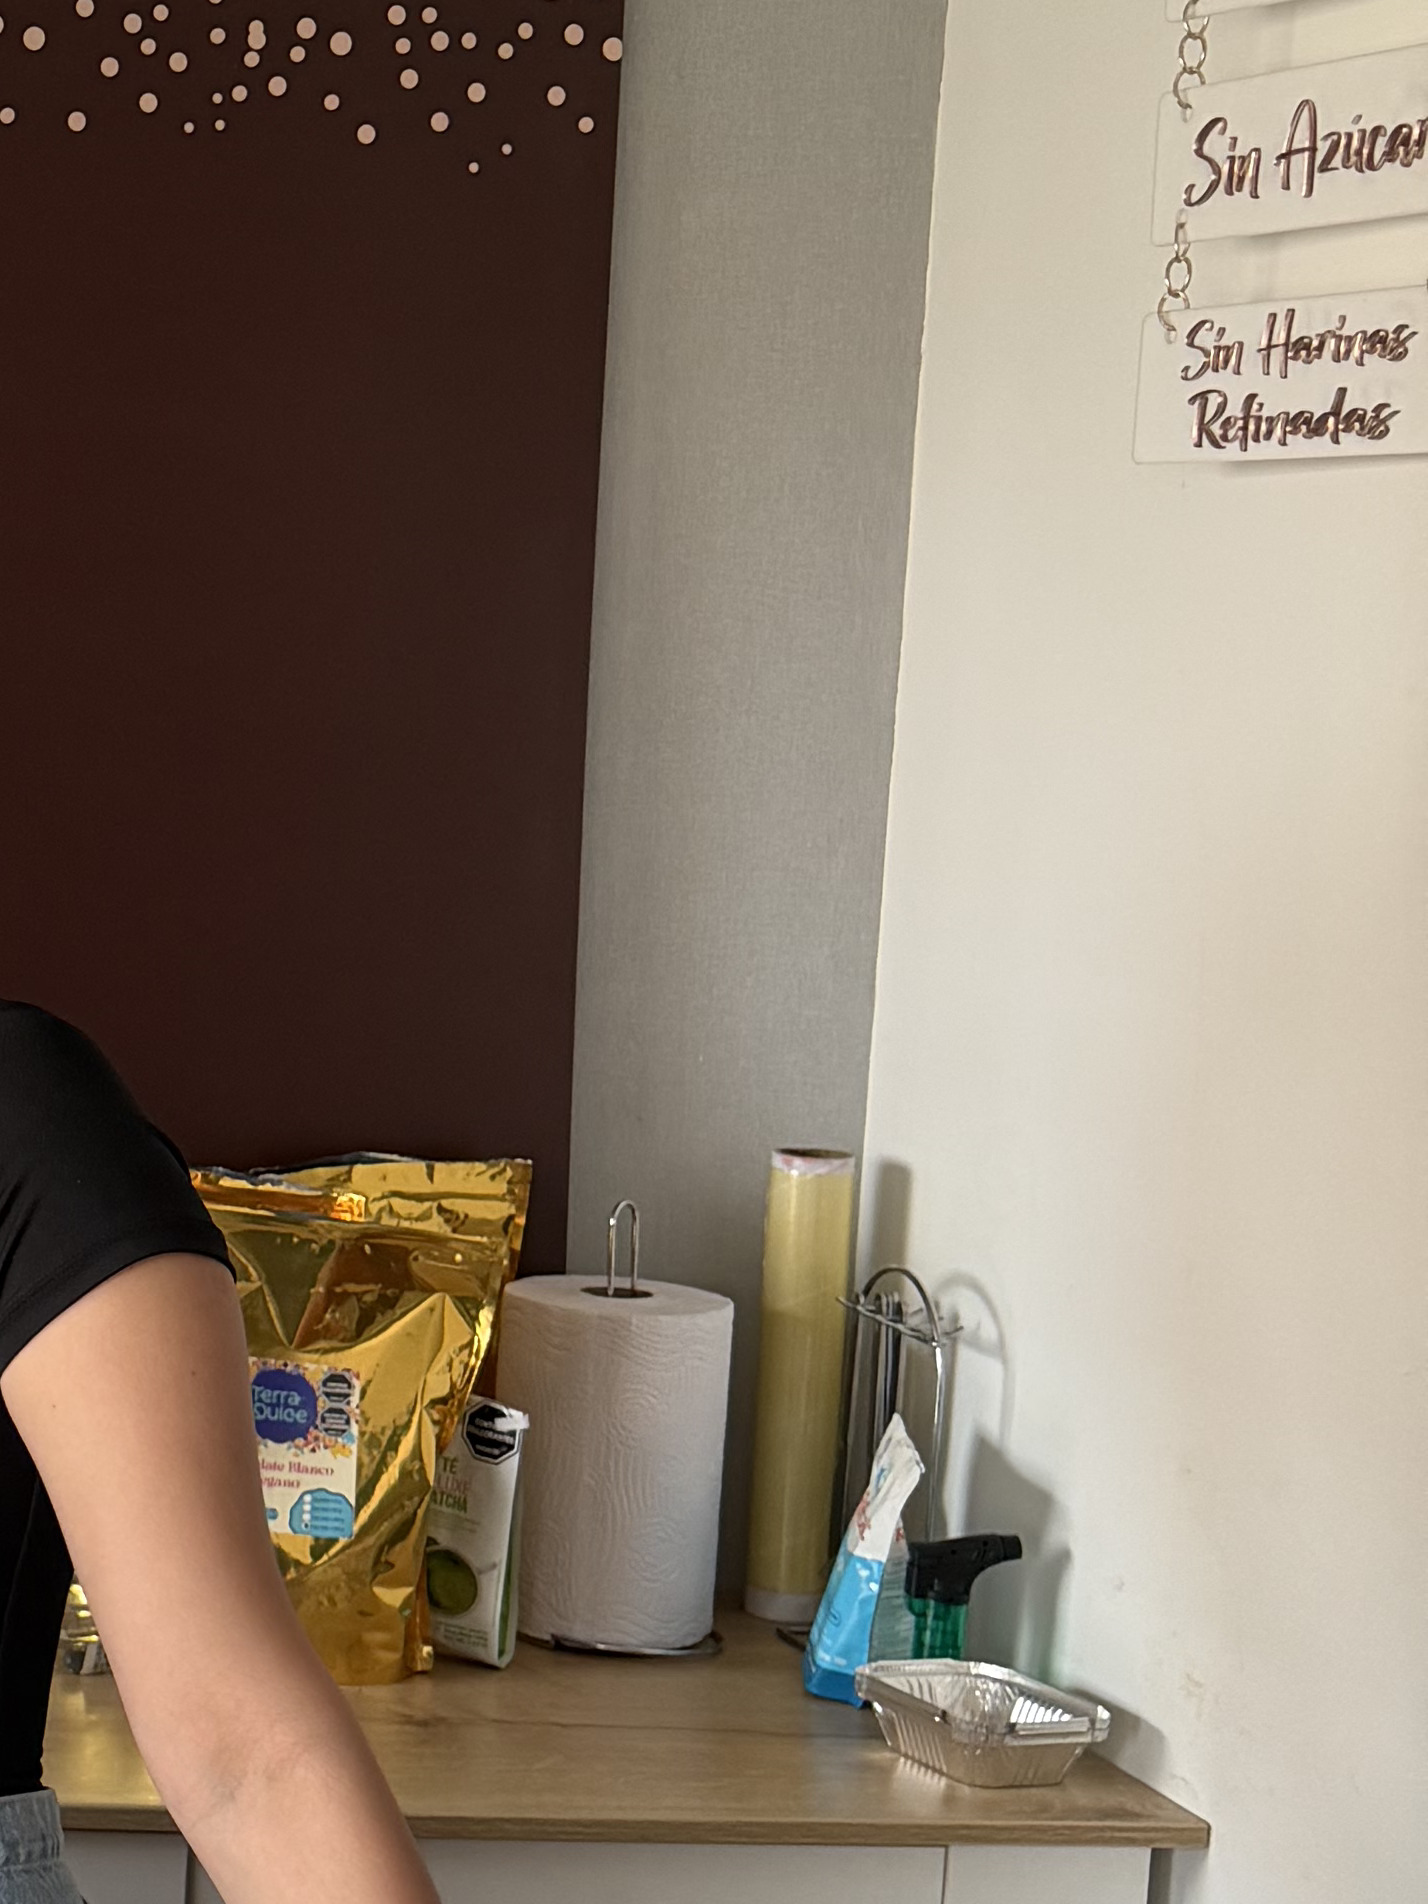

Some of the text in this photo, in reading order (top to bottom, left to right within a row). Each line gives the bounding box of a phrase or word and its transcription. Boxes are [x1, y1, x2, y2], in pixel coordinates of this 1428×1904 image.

[1183, 116, 1260, 207] Sin
[1180, 308, 1419, 381] Sin Harinas
[1187, 387, 1402, 452] Refinadas
[252, 1384, 301, 1406] Terra
[429, 1488, 468, 1514] ATCHA
